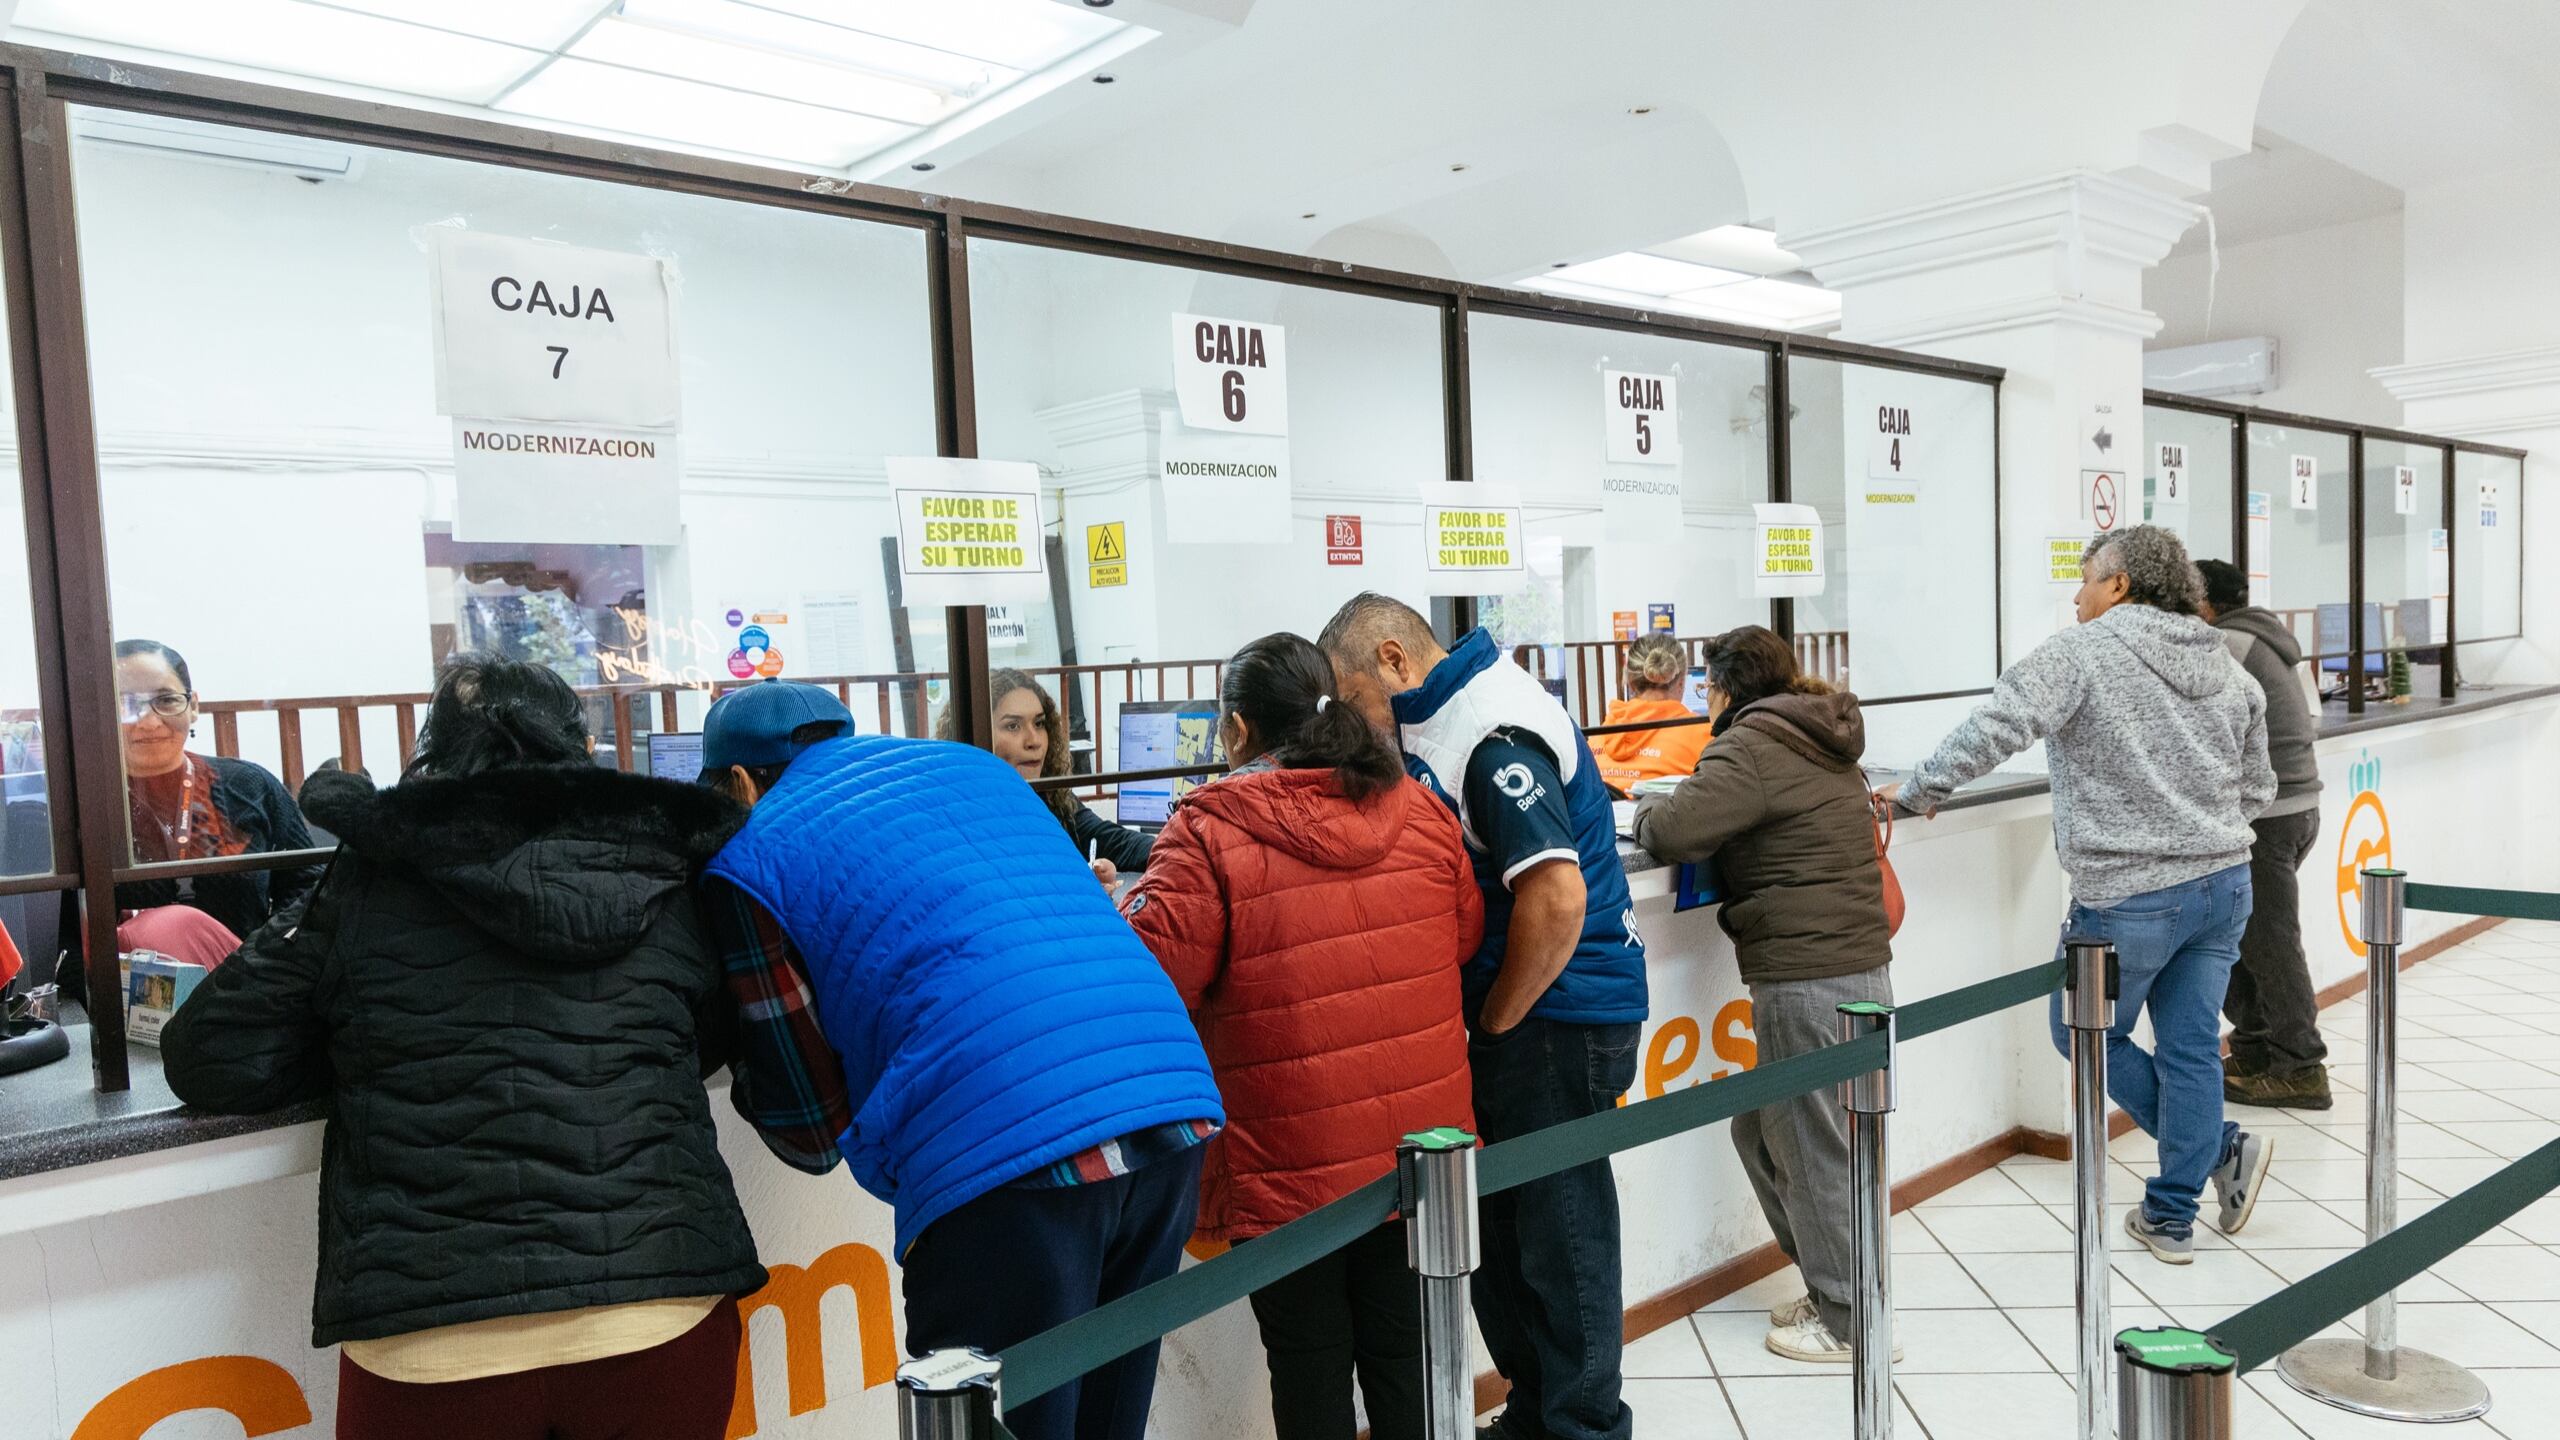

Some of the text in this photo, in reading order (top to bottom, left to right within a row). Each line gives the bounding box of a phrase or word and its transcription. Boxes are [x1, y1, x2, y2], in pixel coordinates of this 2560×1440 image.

[490, 275, 615, 323] CAJA
[1194, 320, 1267, 369] CAJA
[546, 345, 569, 380] 7
[1221, 369, 1247, 423] 6
[1618, 375, 1665, 412] CAJA
[1878, 405, 1912, 436] CAJA
[462, 430, 656, 459] MODERNIZACION
[1635, 413, 1652, 456] 5
[1890, 438, 1901, 472] 4
[2162, 446, 2183, 468] CAJA
[1165, 461, 1278, 479] MODERNIZACION
[1602, 478, 1680, 497] MODERNIZACION
[2169, 471, 2177, 498] 3
[2301, 479, 2307, 504] 2
[921, 496, 1019, 519] FAVOR DE
[1865, 493, 1916, 504] MODERNIZACION
[2404, 489, 2409, 510] 1
[1439, 511, 1507, 529] FAVOR DE
[926, 521, 1018, 543] ESPERAR
[1440, 530, 1505, 547] ESPERAR
[1767, 528, 1811, 541] FAVOR DE
[921, 545, 1024, 567] SU TURNO
[1329, 552, 1361, 562] EXTINTOR
[1439, 549, 1510, 566] SU TURNO
[1767, 543, 1811, 557] ESPERAR
[1765, 559, 1813, 572] SU TURNO
[1516, 783, 1547, 812] Berel
